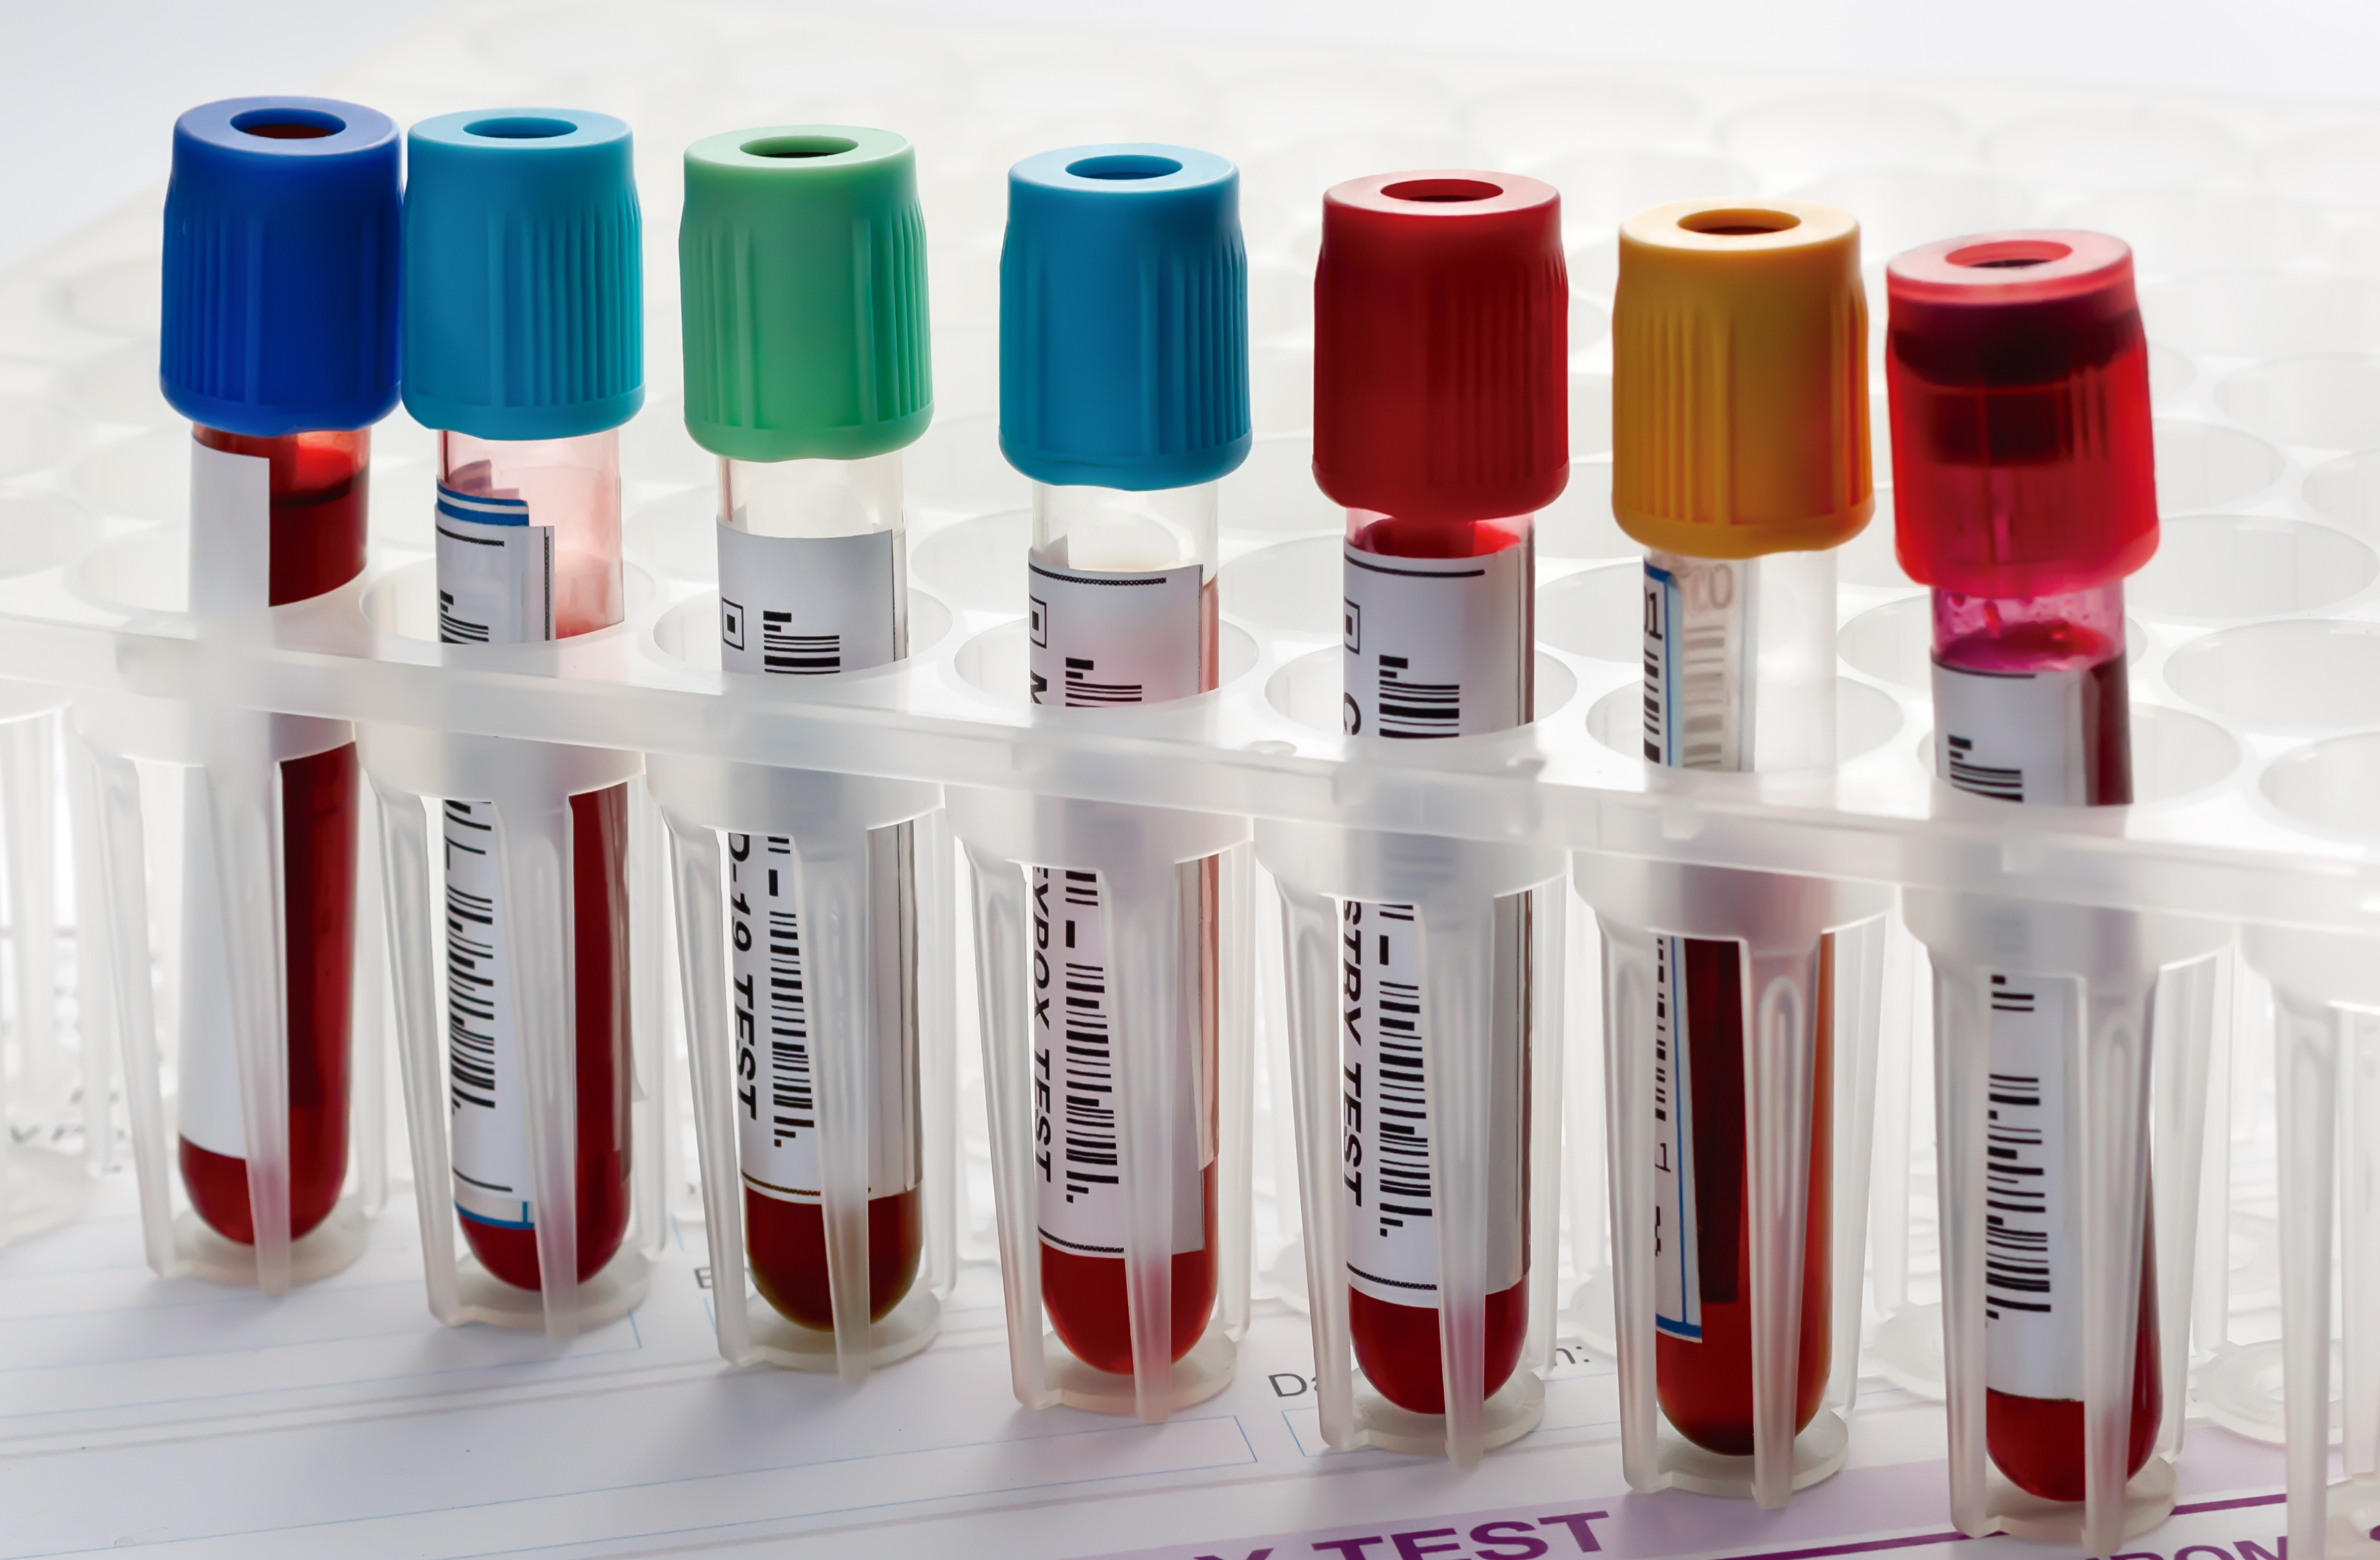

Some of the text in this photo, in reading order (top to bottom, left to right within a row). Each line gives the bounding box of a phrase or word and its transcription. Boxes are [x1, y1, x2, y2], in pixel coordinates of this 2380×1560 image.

[734, 974, 756, 1121] TEST
[1035, 1049, 1051, 1182] TEST
[1344, 1062, 1362, 1207] TEST
